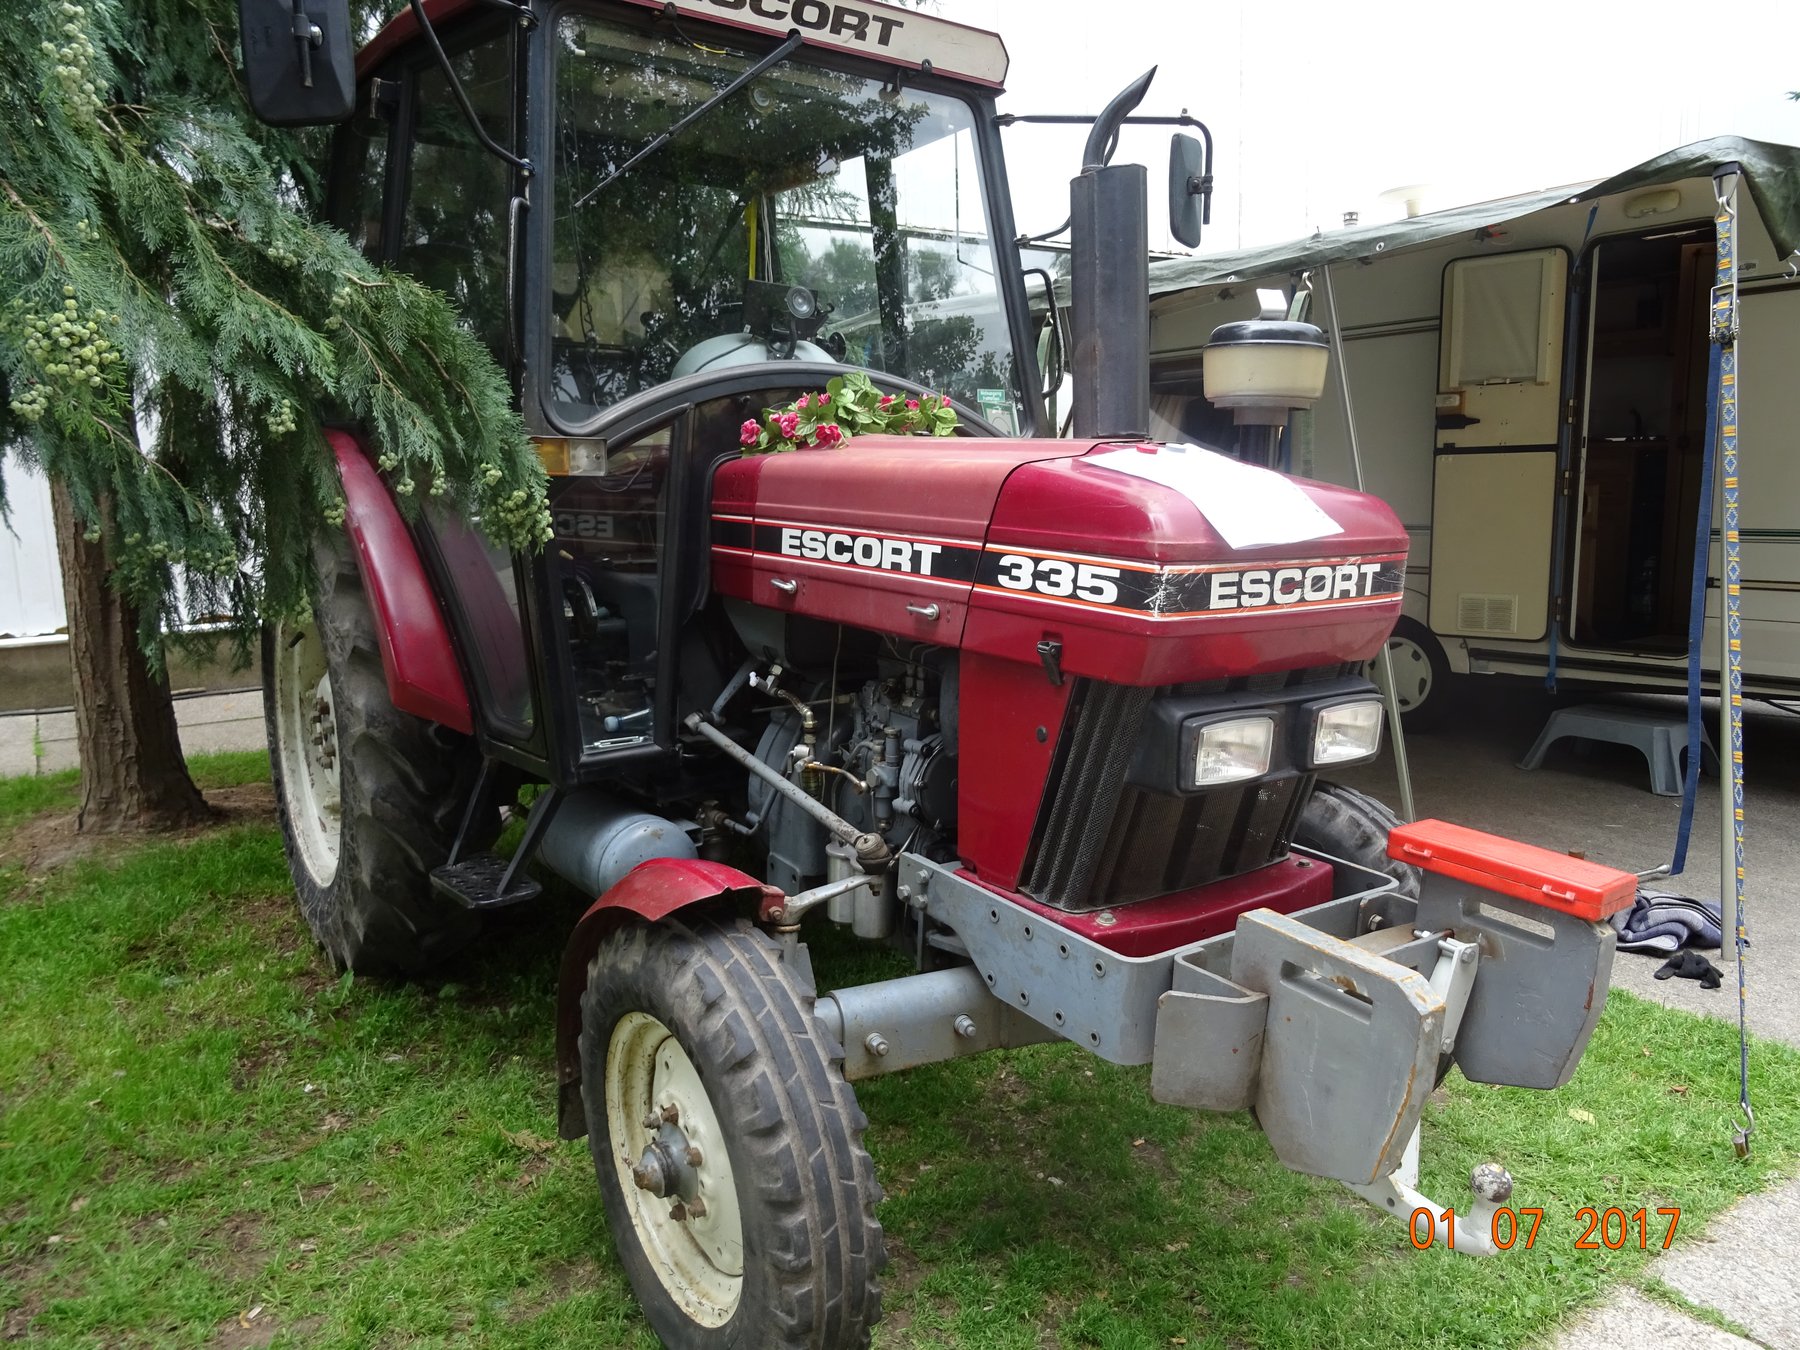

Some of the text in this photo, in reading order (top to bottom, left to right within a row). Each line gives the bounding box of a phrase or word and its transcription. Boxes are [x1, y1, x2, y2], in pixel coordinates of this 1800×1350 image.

[696, 0, 905, 47] CORT
[780, 527, 1121, 605] ESCORT 335
[1208, 562, 1381, 610] ESCORT
